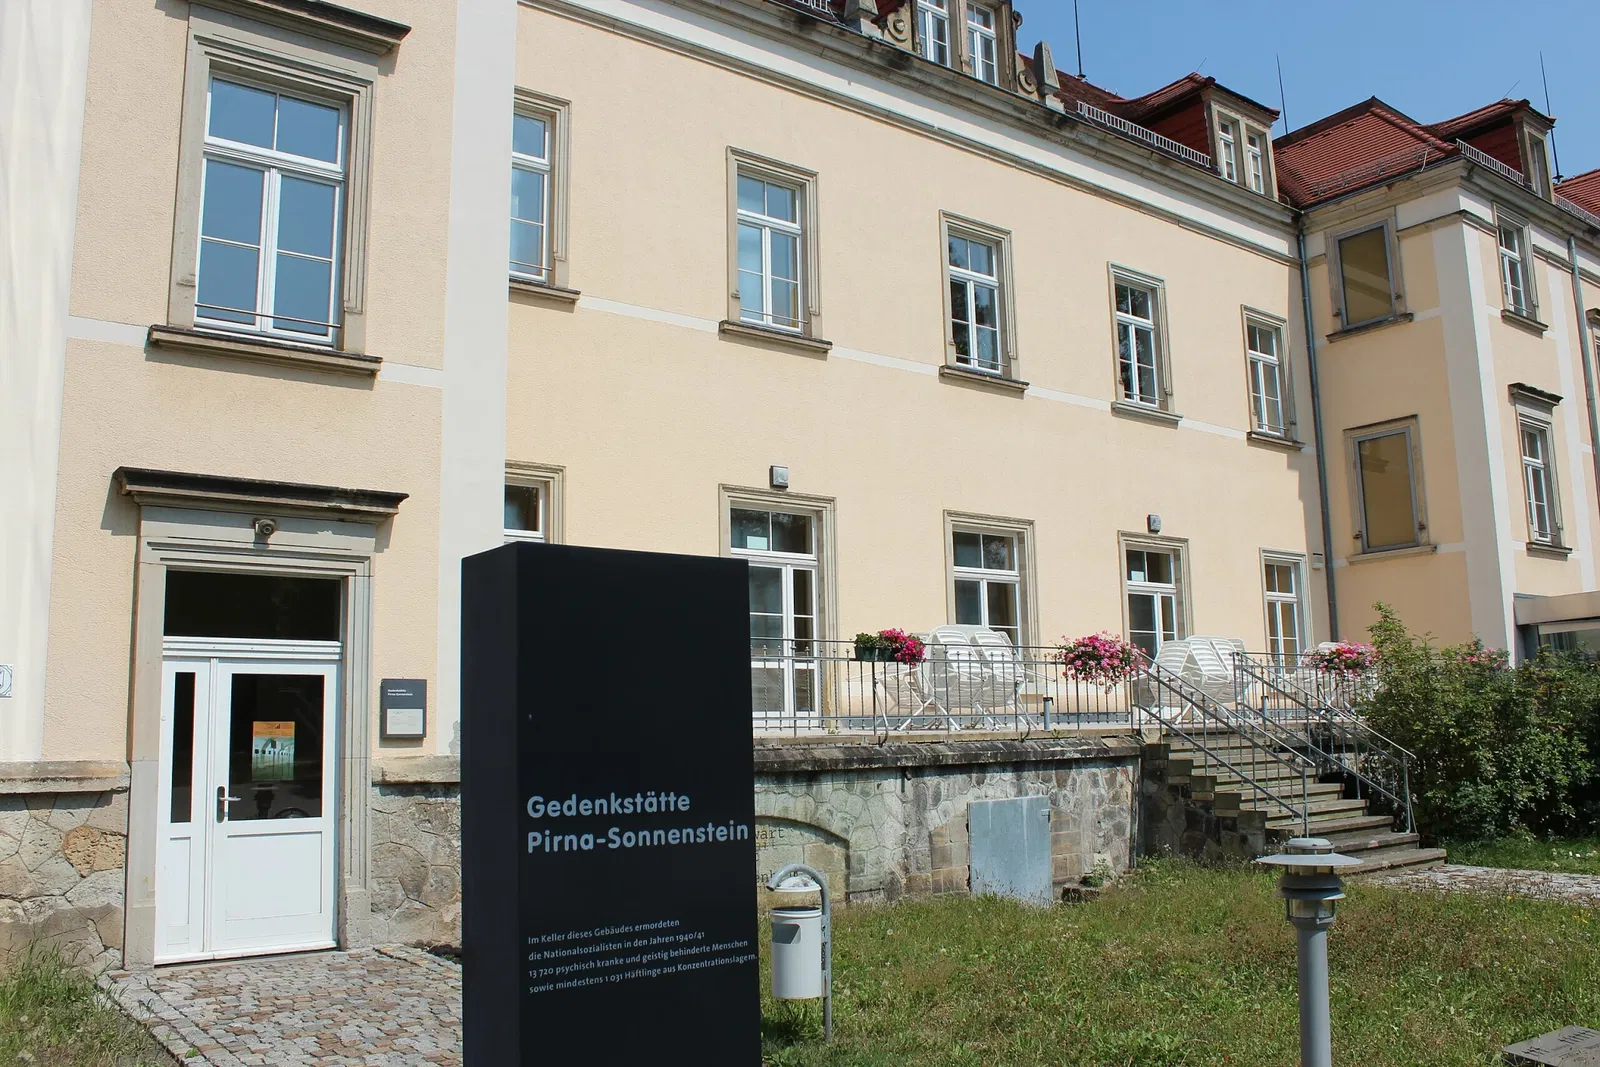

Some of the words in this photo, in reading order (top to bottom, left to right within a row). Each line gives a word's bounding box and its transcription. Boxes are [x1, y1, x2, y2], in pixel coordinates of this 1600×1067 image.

[527, 791, 690, 818] Gedenkstätte
[528, 820, 748, 853] Pirna-Sonnenstein
[541, 933, 565, 942] Keller
[567, 931, 592, 940] dieses
[594, 926, 633, 936] Gebäudes
[635, 920, 680, 931] ermordeten
[528, 952, 541, 960] die
[544, 943, 622, 958] Nationalsozialisten
[624, 940, 631, 948] in
[650, 936, 674, 945] Jahren
[676, 932, 705, 942] 1940/41
[556, 961, 595, 975] psychisch
[597, 958, 623, 968] kranke
[626, 954, 640, 962] und
[642, 950, 668, 964] geistig
[670, 946, 710, 957] behinderte
[712, 940, 748, 951] Menschen
[530, 983, 554, 993] sowie
[556, 976, 603, 989] mindestens
[624, 969, 661, 978] Häftlinge
